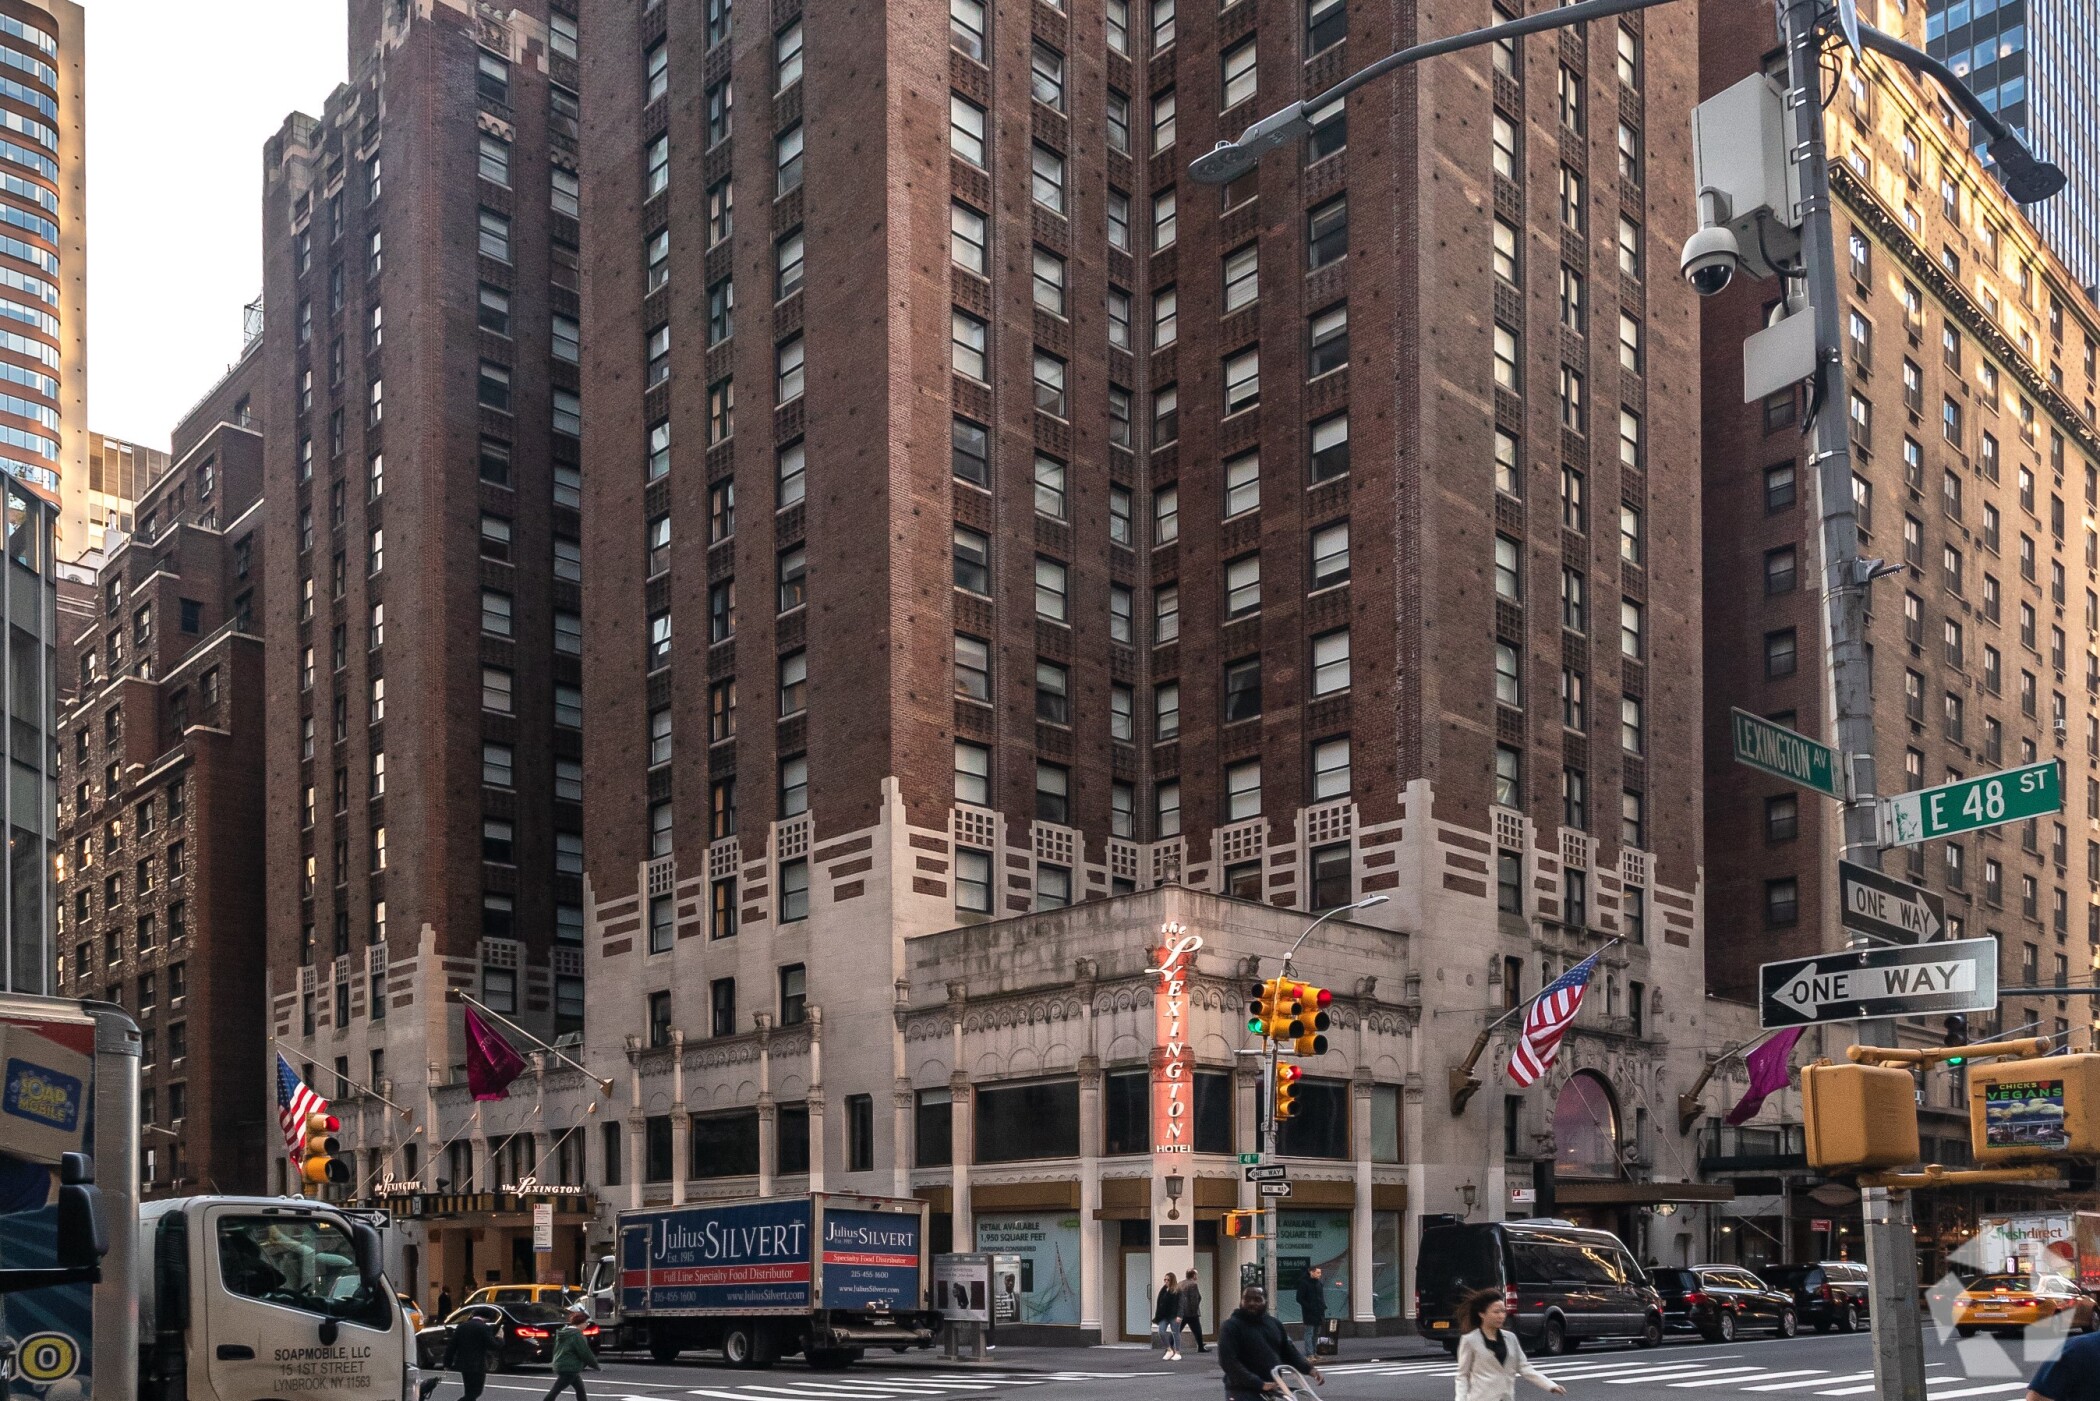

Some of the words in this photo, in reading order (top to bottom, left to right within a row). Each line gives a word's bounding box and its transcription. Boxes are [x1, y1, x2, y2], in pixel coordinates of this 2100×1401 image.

[1737, 716, 1811, 780] LEXINGTON
[1813, 748, 1827, 769] AV
[1930, 793, 1949, 831] E
[1962, 780, 2005, 822] 48
[2019, 769, 2048, 793] ST
[1856, 887, 1887, 920] ONE
[1900, 899, 1931, 934] WAY
[1161, 922, 1187, 934] the
[1792, 974, 1849, 1004] ONE
[1884, 964, 1960, 994] WAY
[1144, 935, 1204, 1140] LEXINGTON
[1999, 1082, 2038, 1090] CHICKS
[1987, 1087, 2062, 1100] VEGANS
[18, 1098, 66, 1122] MOBILE
[510, 1177, 580, 1198] LEXINGTON
[980, 1223, 1001, 1231] RETAIL
[1003, 1222, 1040, 1230] AVAILABLE
[655, 1219, 705, 1259] Julius
[704, 1220, 806, 1259] SILVERT
[826, 1222, 858, 1240] Julius
[859, 1228, 914, 1246] SILVERT
[980, 1233, 999, 1242] 1,950
[1000, 1233, 1028, 1242] SQUARE
[1030, 1233, 1046, 1241] FEET
[1280, 1231, 1306, 1239] SQUARE
[1308, 1231, 1323, 1239] FEET
[667, 1253, 679, 1263] Est.
[680, 1251, 694, 1263] 1915
[833, 1254, 859, 1262] Specialty
[861, 1255, 875, 1263] Food
[876, 1256, 906, 1264] Distributor
[664, 1271, 677, 1282] Full
[678, 1271, 693, 1281] Line
[694, 1269, 727, 1283] Specialty
[729, 1269, 747, 1280] Food
[750, 1267, 793, 1279] Distributor
[727, 1288, 804, 1302] www.JuliusSilvert.com
[274, 1347, 348, 1361] SOAPMOBILE,
[352, 1346, 371, 1358] LLC
[321, 1361, 365, 1374] STREET
[331, 1377, 344, 1388] NY
[346, 1376, 370, 1388] 11563
